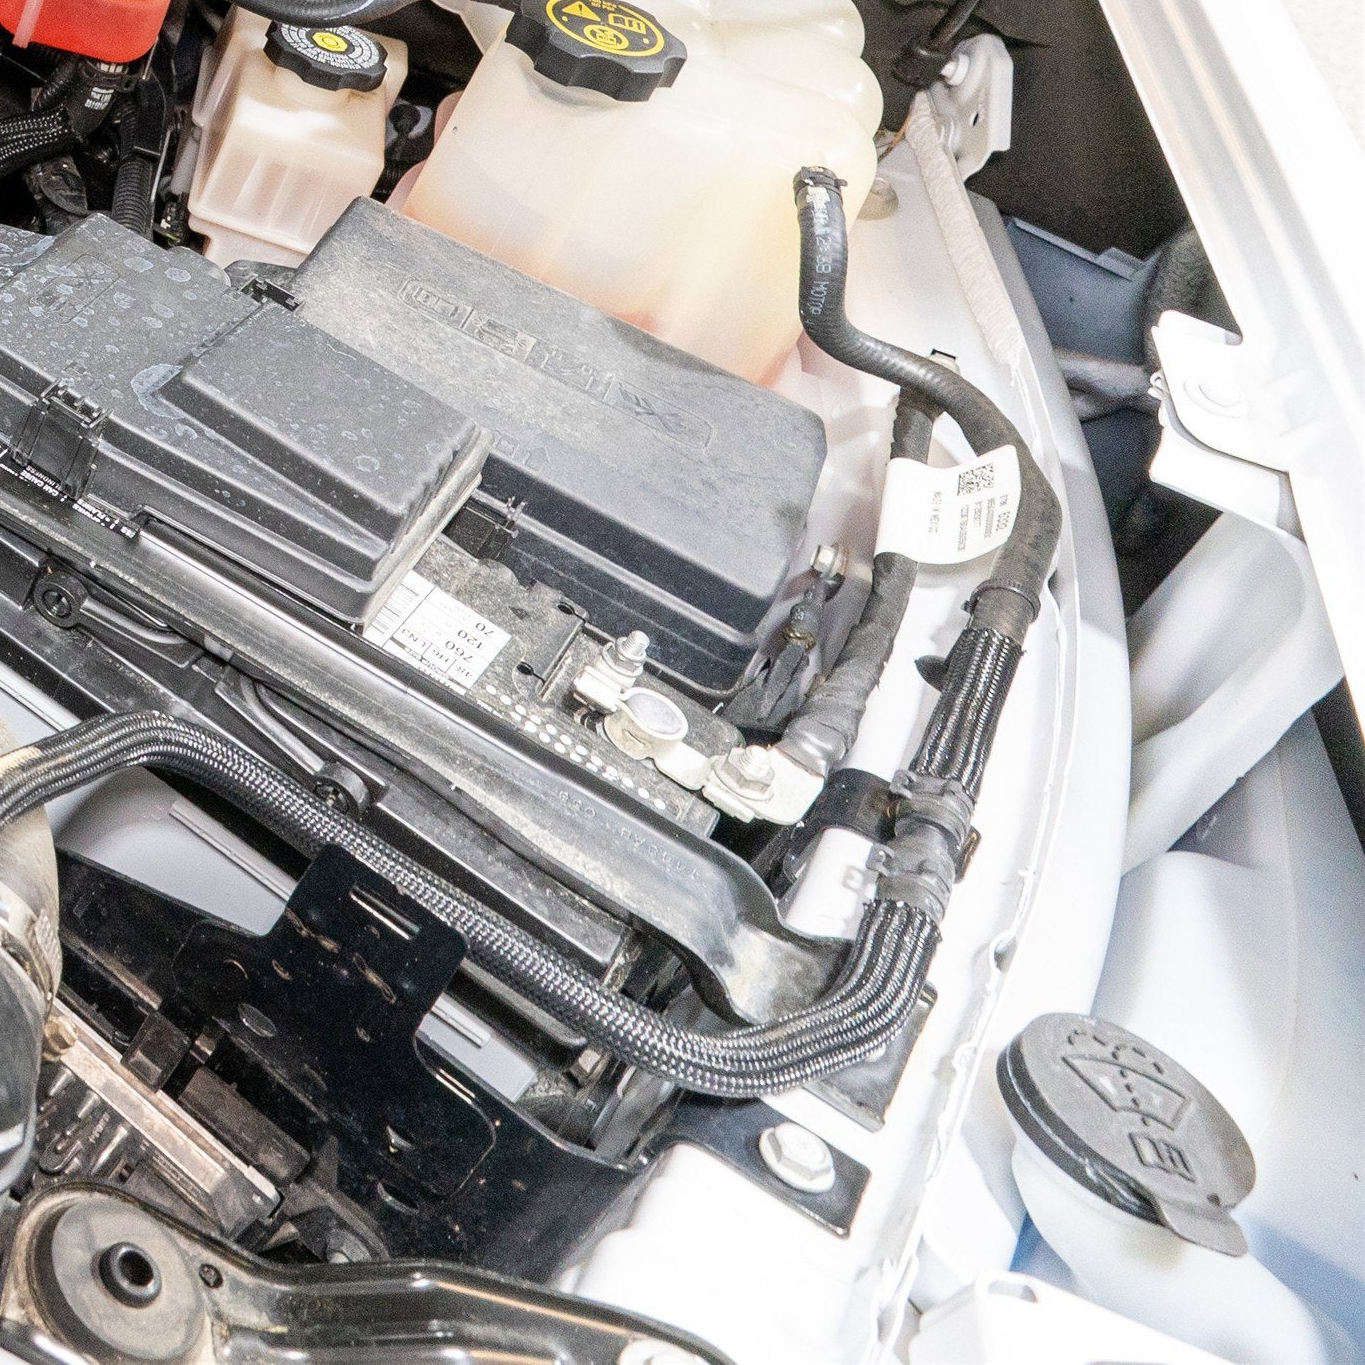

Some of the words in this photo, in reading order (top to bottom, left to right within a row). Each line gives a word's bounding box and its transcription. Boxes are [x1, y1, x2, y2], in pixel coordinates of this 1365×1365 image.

[19, 469, 44, 488] CAUSE
[42, 483, 61, 497] CAN
[76, 498, 105, 520] FLAMES
[475, 622, 495, 636] 70
[457, 629, 483, 649] 120
[444, 640, 473, 662] 760
